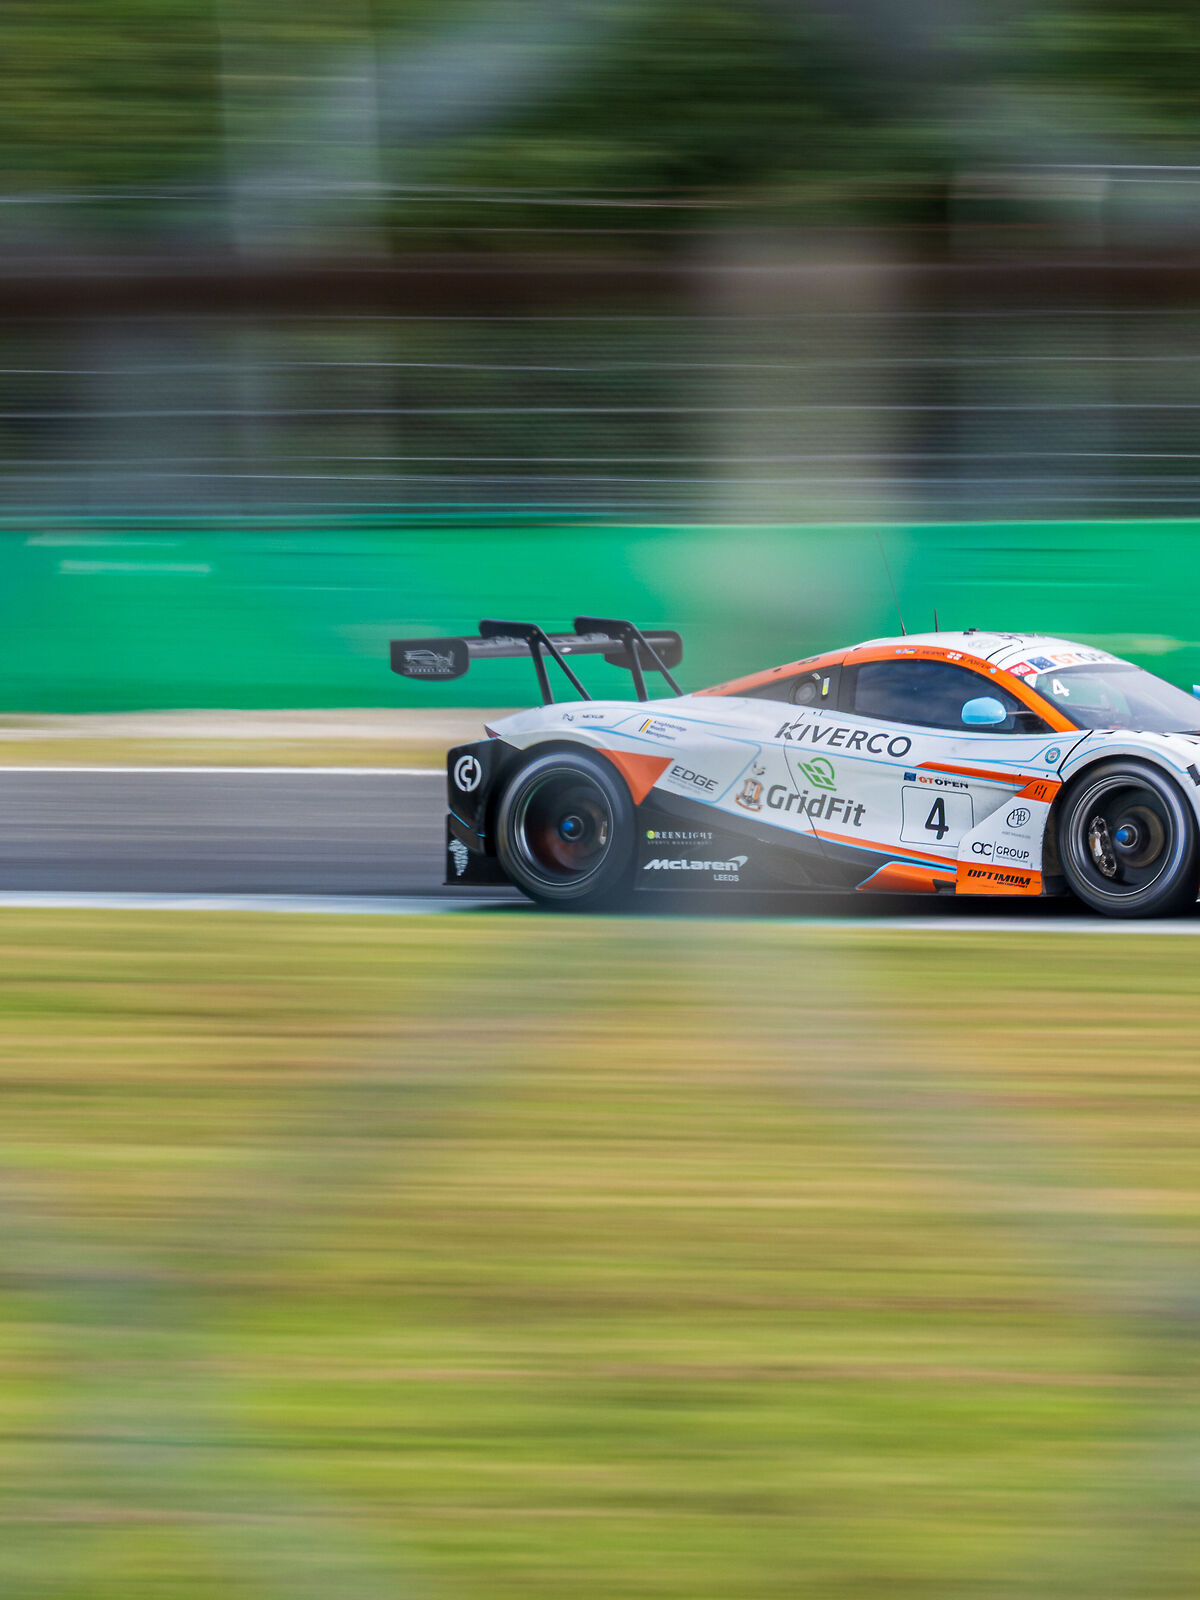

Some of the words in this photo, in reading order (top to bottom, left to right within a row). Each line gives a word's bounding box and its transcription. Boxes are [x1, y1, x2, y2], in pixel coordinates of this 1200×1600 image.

[1052, 678, 1070, 697] 4
[774, 721, 912, 758] KIVERCO
[671, 764, 719, 791] EDGE
[766, 784, 866, 827] GridFit
[925, 797, 949, 840] 4
[646, 830, 713, 840] GREENLIGHT
[996, 845, 1030, 859] GROUP
[643, 858, 739, 872] McLaren
[713, 874, 740, 882] LEEDS
[967, 869, 1032, 886] OPTIMUM
